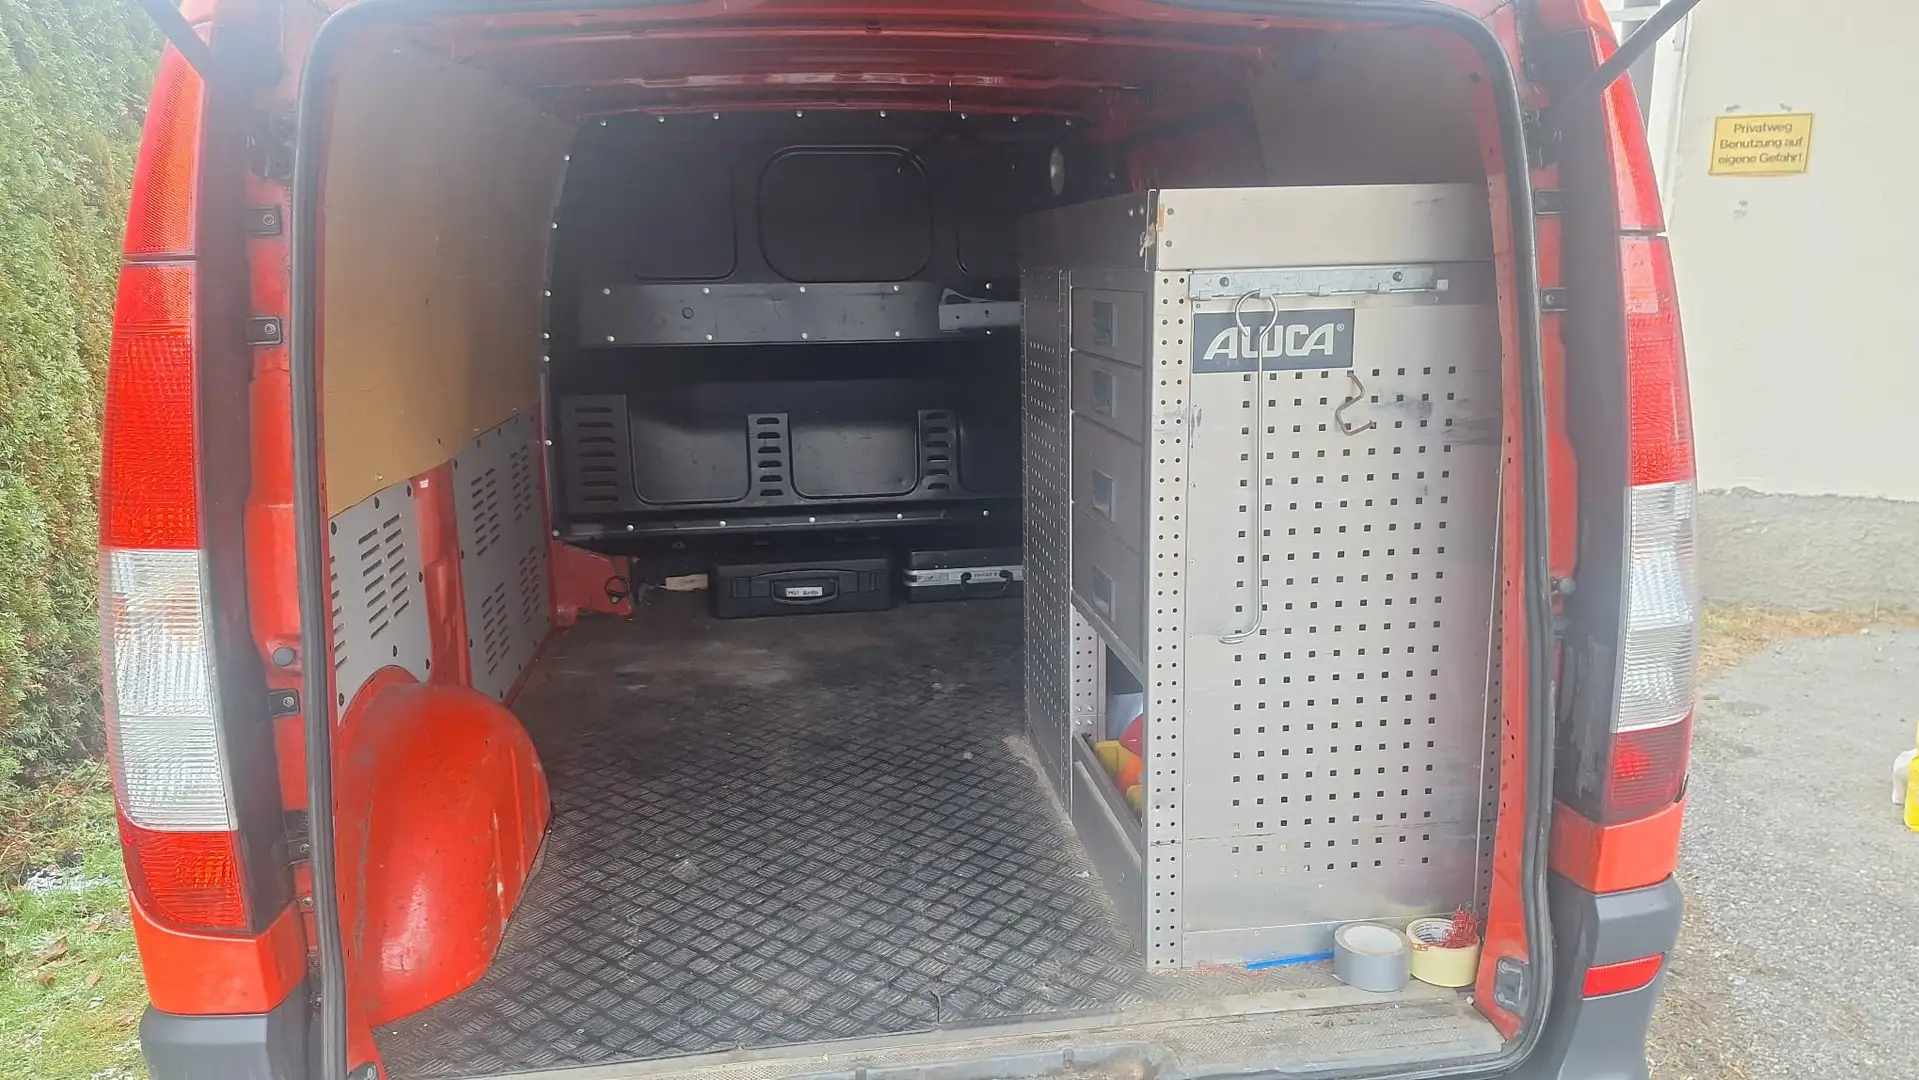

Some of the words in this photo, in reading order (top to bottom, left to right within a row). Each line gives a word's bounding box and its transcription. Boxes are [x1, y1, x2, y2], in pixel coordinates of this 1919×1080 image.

[1733, 122, 1793, 134] Privatweg
[1719, 138, 1782, 150] Benutzung
[1784, 136, 1803, 147] auf
[1718, 153, 1757, 166] eigene
[1759, 152, 1802, 164] Gefahr!
